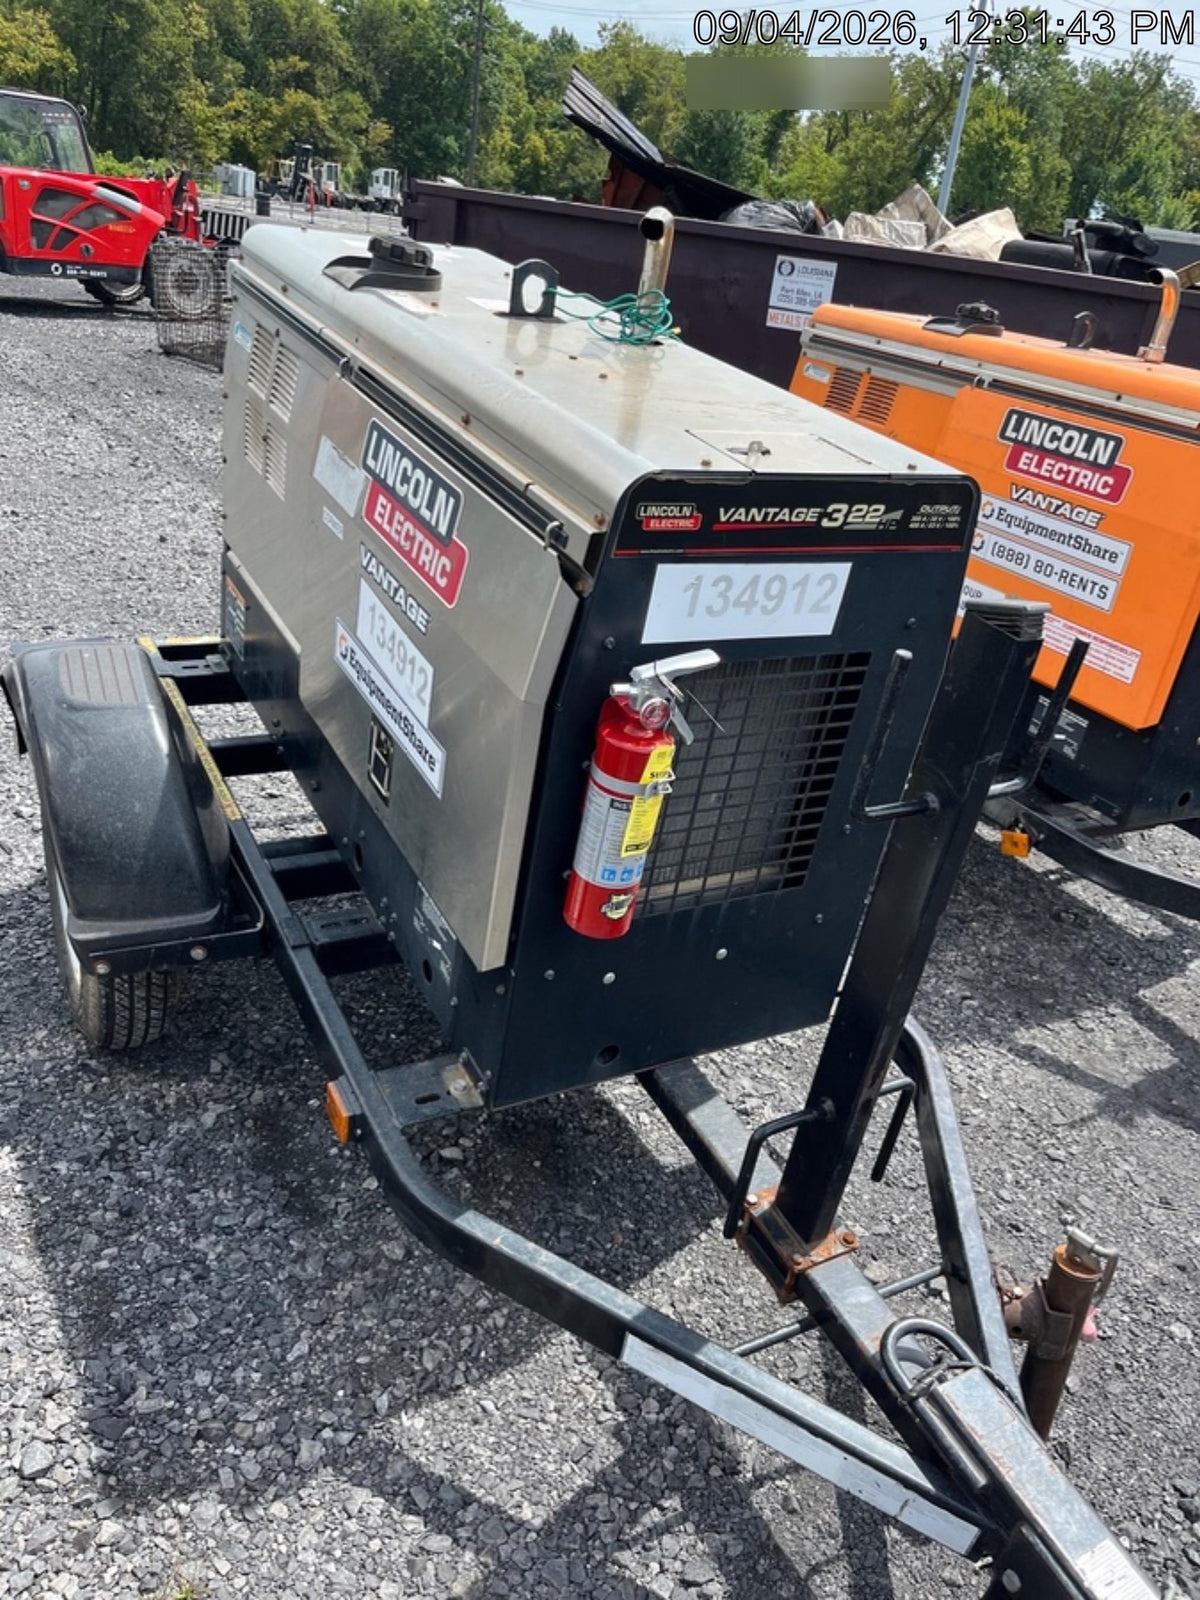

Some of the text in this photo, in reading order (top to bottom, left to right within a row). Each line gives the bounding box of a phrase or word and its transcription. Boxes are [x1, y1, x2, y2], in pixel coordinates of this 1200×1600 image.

[1004, 414, 1116, 466] LINCOLN
[365, 429, 456, 538] LINCOLN
[1017, 451, 1114, 496] ELECTRIC
[639, 505, 693, 517] LINCOLN
[649, 518, 695, 528] ELECTRIC
[718, 507, 821, 522] VANTAGE
[820, 502, 886, 528] 322
[1010, 483, 1104, 528] VANTAGE
[373, 493, 452, 589] ELECTRIC
[995, 506, 1120, 564] EquipmentShare
[359, 542, 432, 635] VANTAGE
[683, 572, 839, 618] 134912
[991, 541, 1110, 601] (888) 80-RENTS
[368, 602, 430, 707] 134912
[348, 648, 438, 774] EquipmentShare
